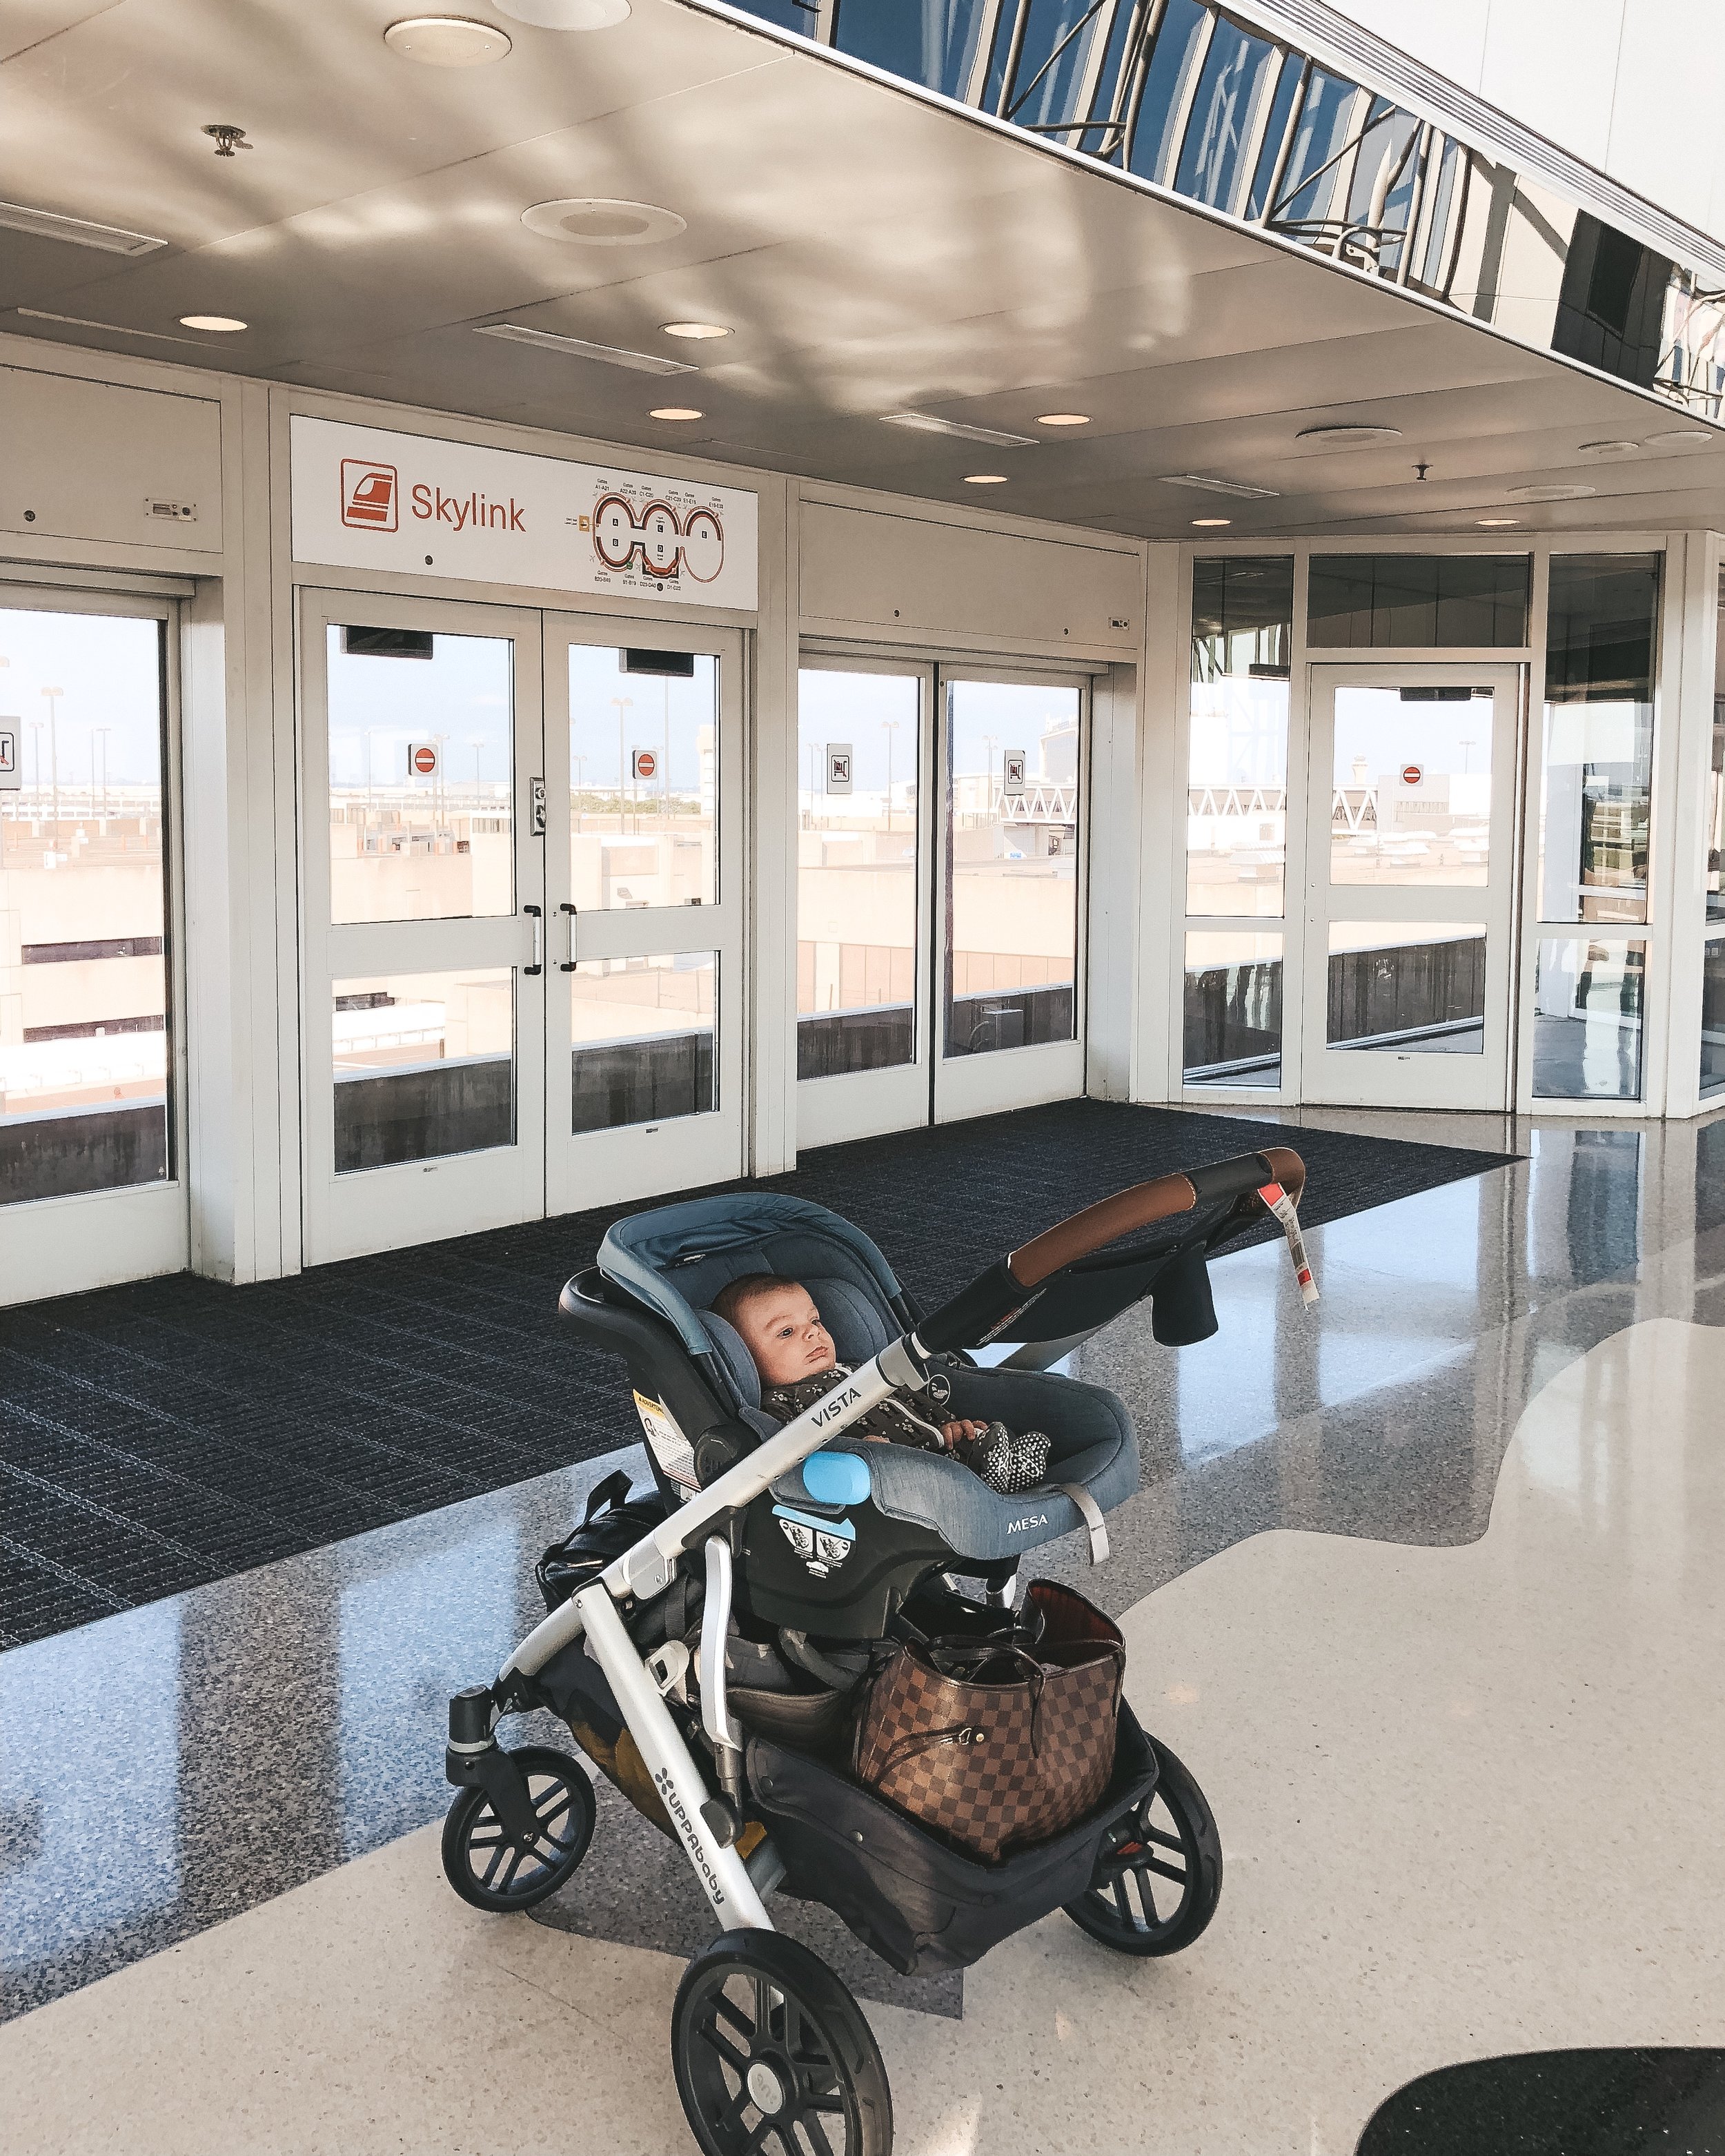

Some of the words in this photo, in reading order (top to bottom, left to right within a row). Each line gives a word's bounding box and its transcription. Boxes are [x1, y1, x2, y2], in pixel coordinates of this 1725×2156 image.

[412, 484, 526, 532] Skylink
[811, 1387, 862, 1427] VISTA
[1007, 1513, 1048, 1535] MESA
[669, 1792, 724, 1905] UPPAbaby
